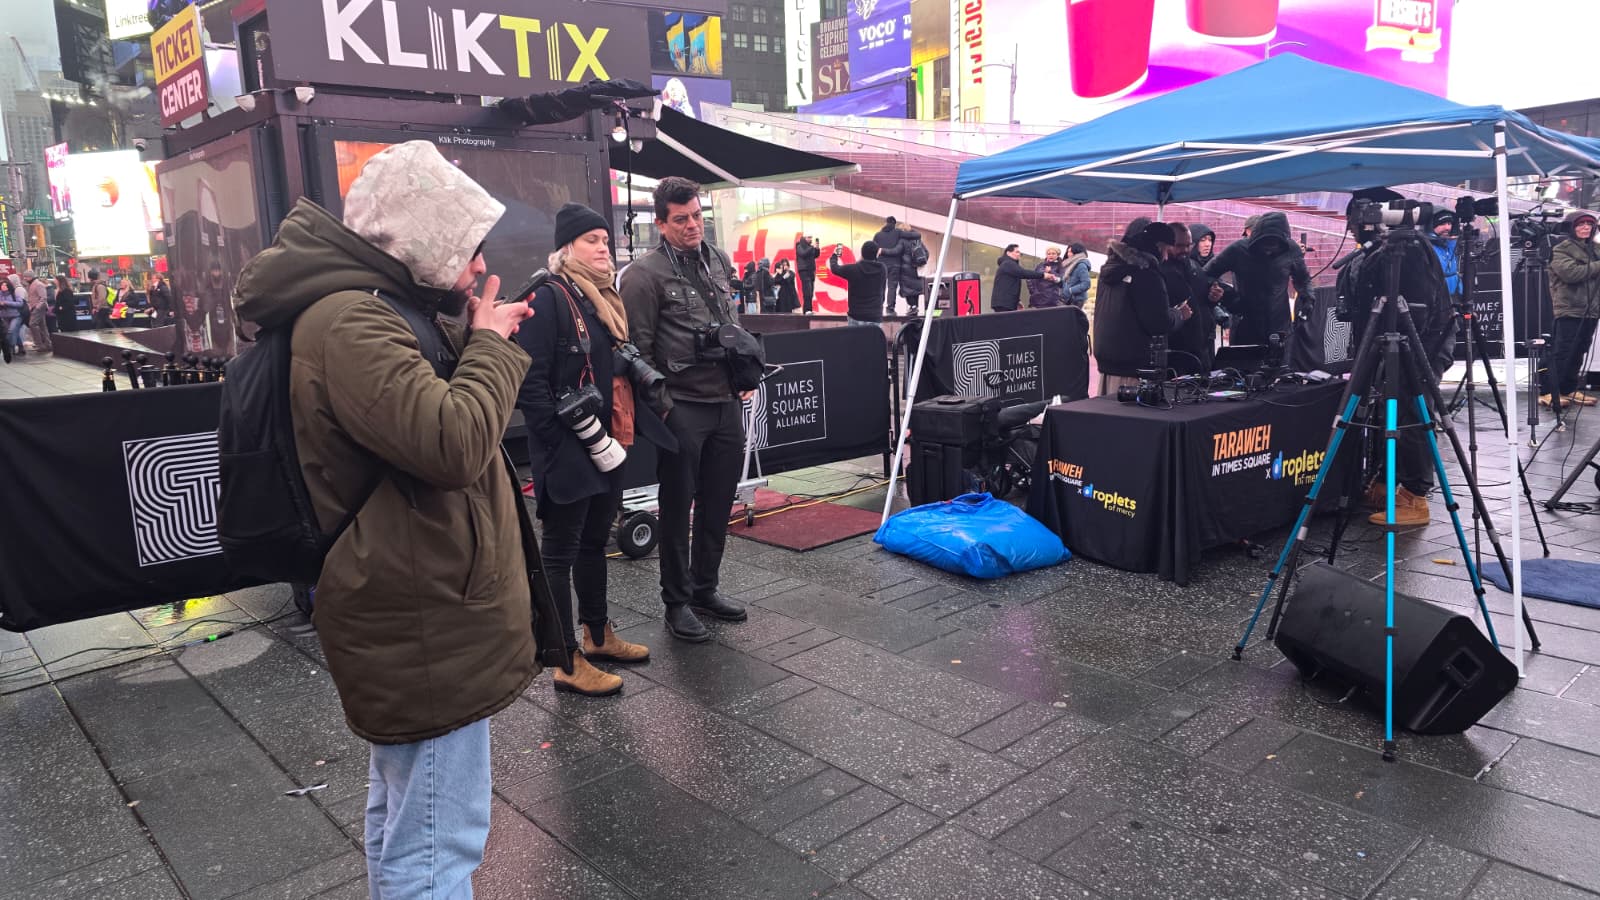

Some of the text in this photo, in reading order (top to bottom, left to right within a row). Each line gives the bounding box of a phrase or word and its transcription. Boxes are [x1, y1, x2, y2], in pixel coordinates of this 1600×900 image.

[155, 18, 195, 76] TICKET
[161, 69, 203, 117] CENTER
[453, 136, 496, 148] Photography
[1006, 351, 1035, 366] TIMES
[1003, 365, 1038, 382] SQUARE
[776, 379, 814, 397] TIMES
[1006, 380, 1036, 393] ALLIANCE
[772, 395, 819, 415] SQUARE
[776, 413, 817, 429] ALLIANCE
[1213, 424, 1271, 461] TARAWEH
[1212, 452, 1271, 477] IN TIMES SQUARE
[1083, 483, 1136, 511] droplets
[1116, 507, 1136, 518] mercy
